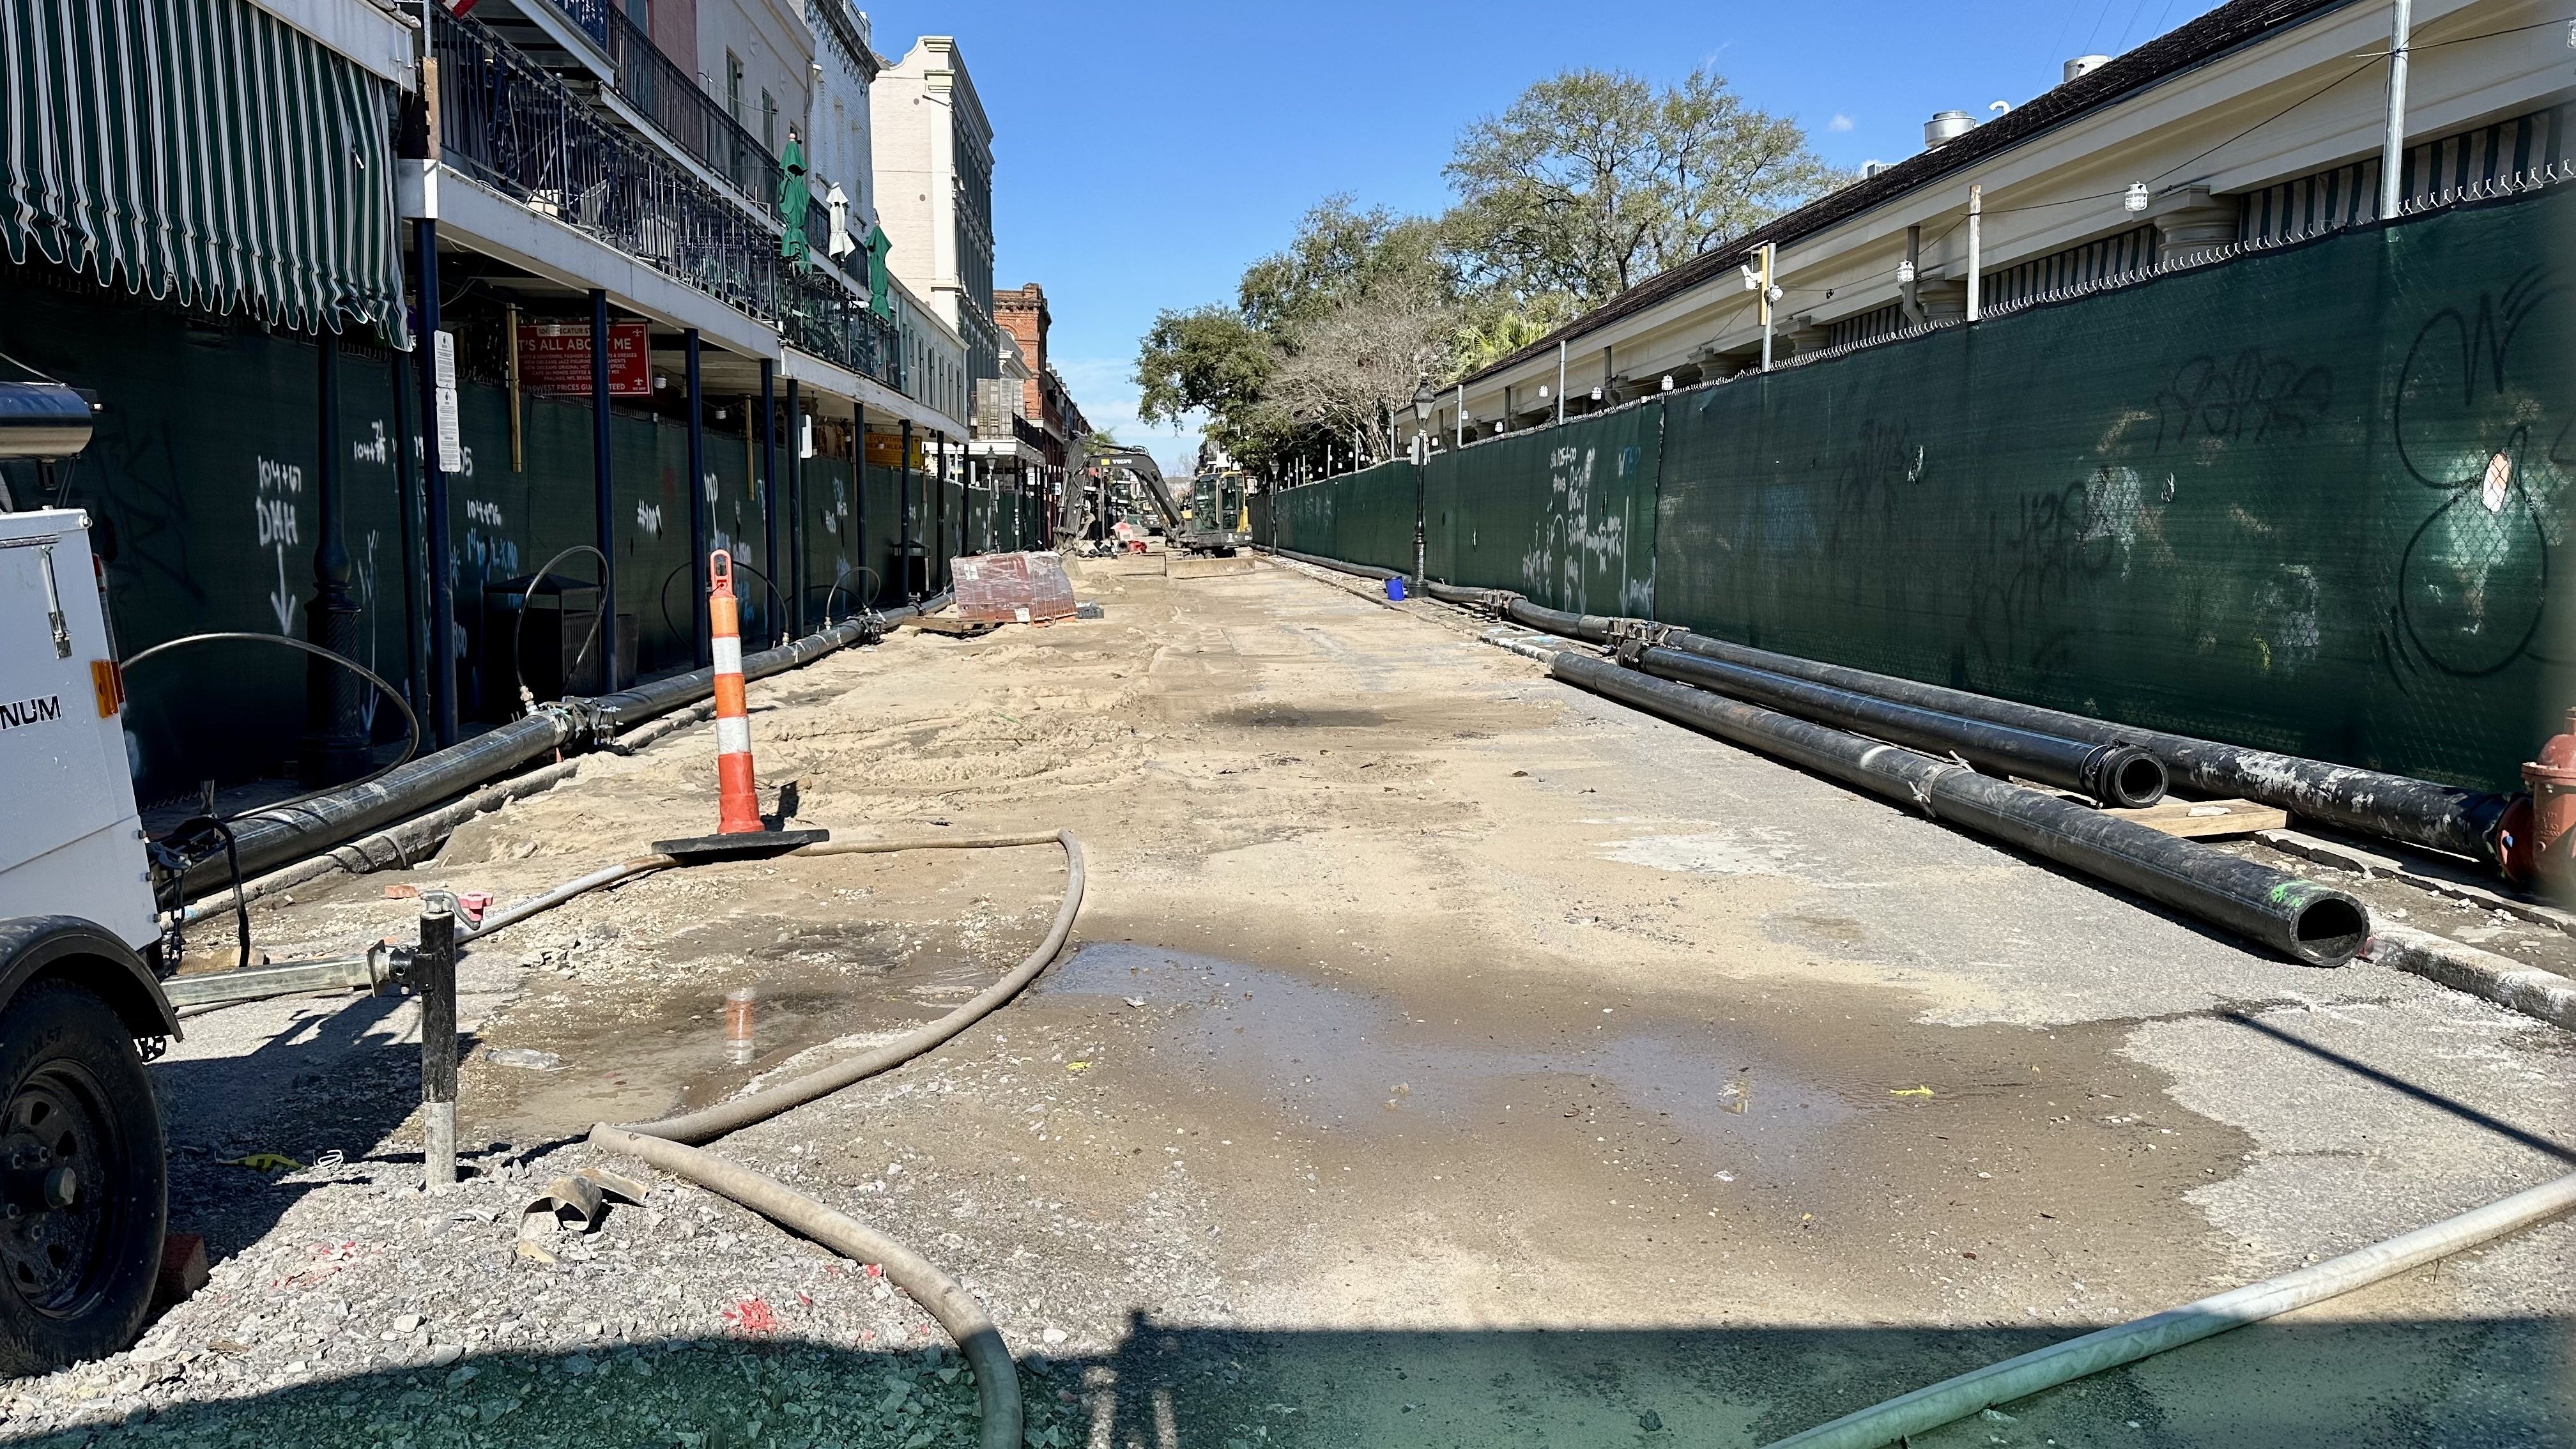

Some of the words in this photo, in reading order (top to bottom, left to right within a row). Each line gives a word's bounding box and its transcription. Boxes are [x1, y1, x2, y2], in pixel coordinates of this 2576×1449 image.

[518, 339, 536, 351] T'S
[540, 339, 563, 351] ALL
[614, 338, 632, 350] ME
[0, 696, 61, 730] NUM
